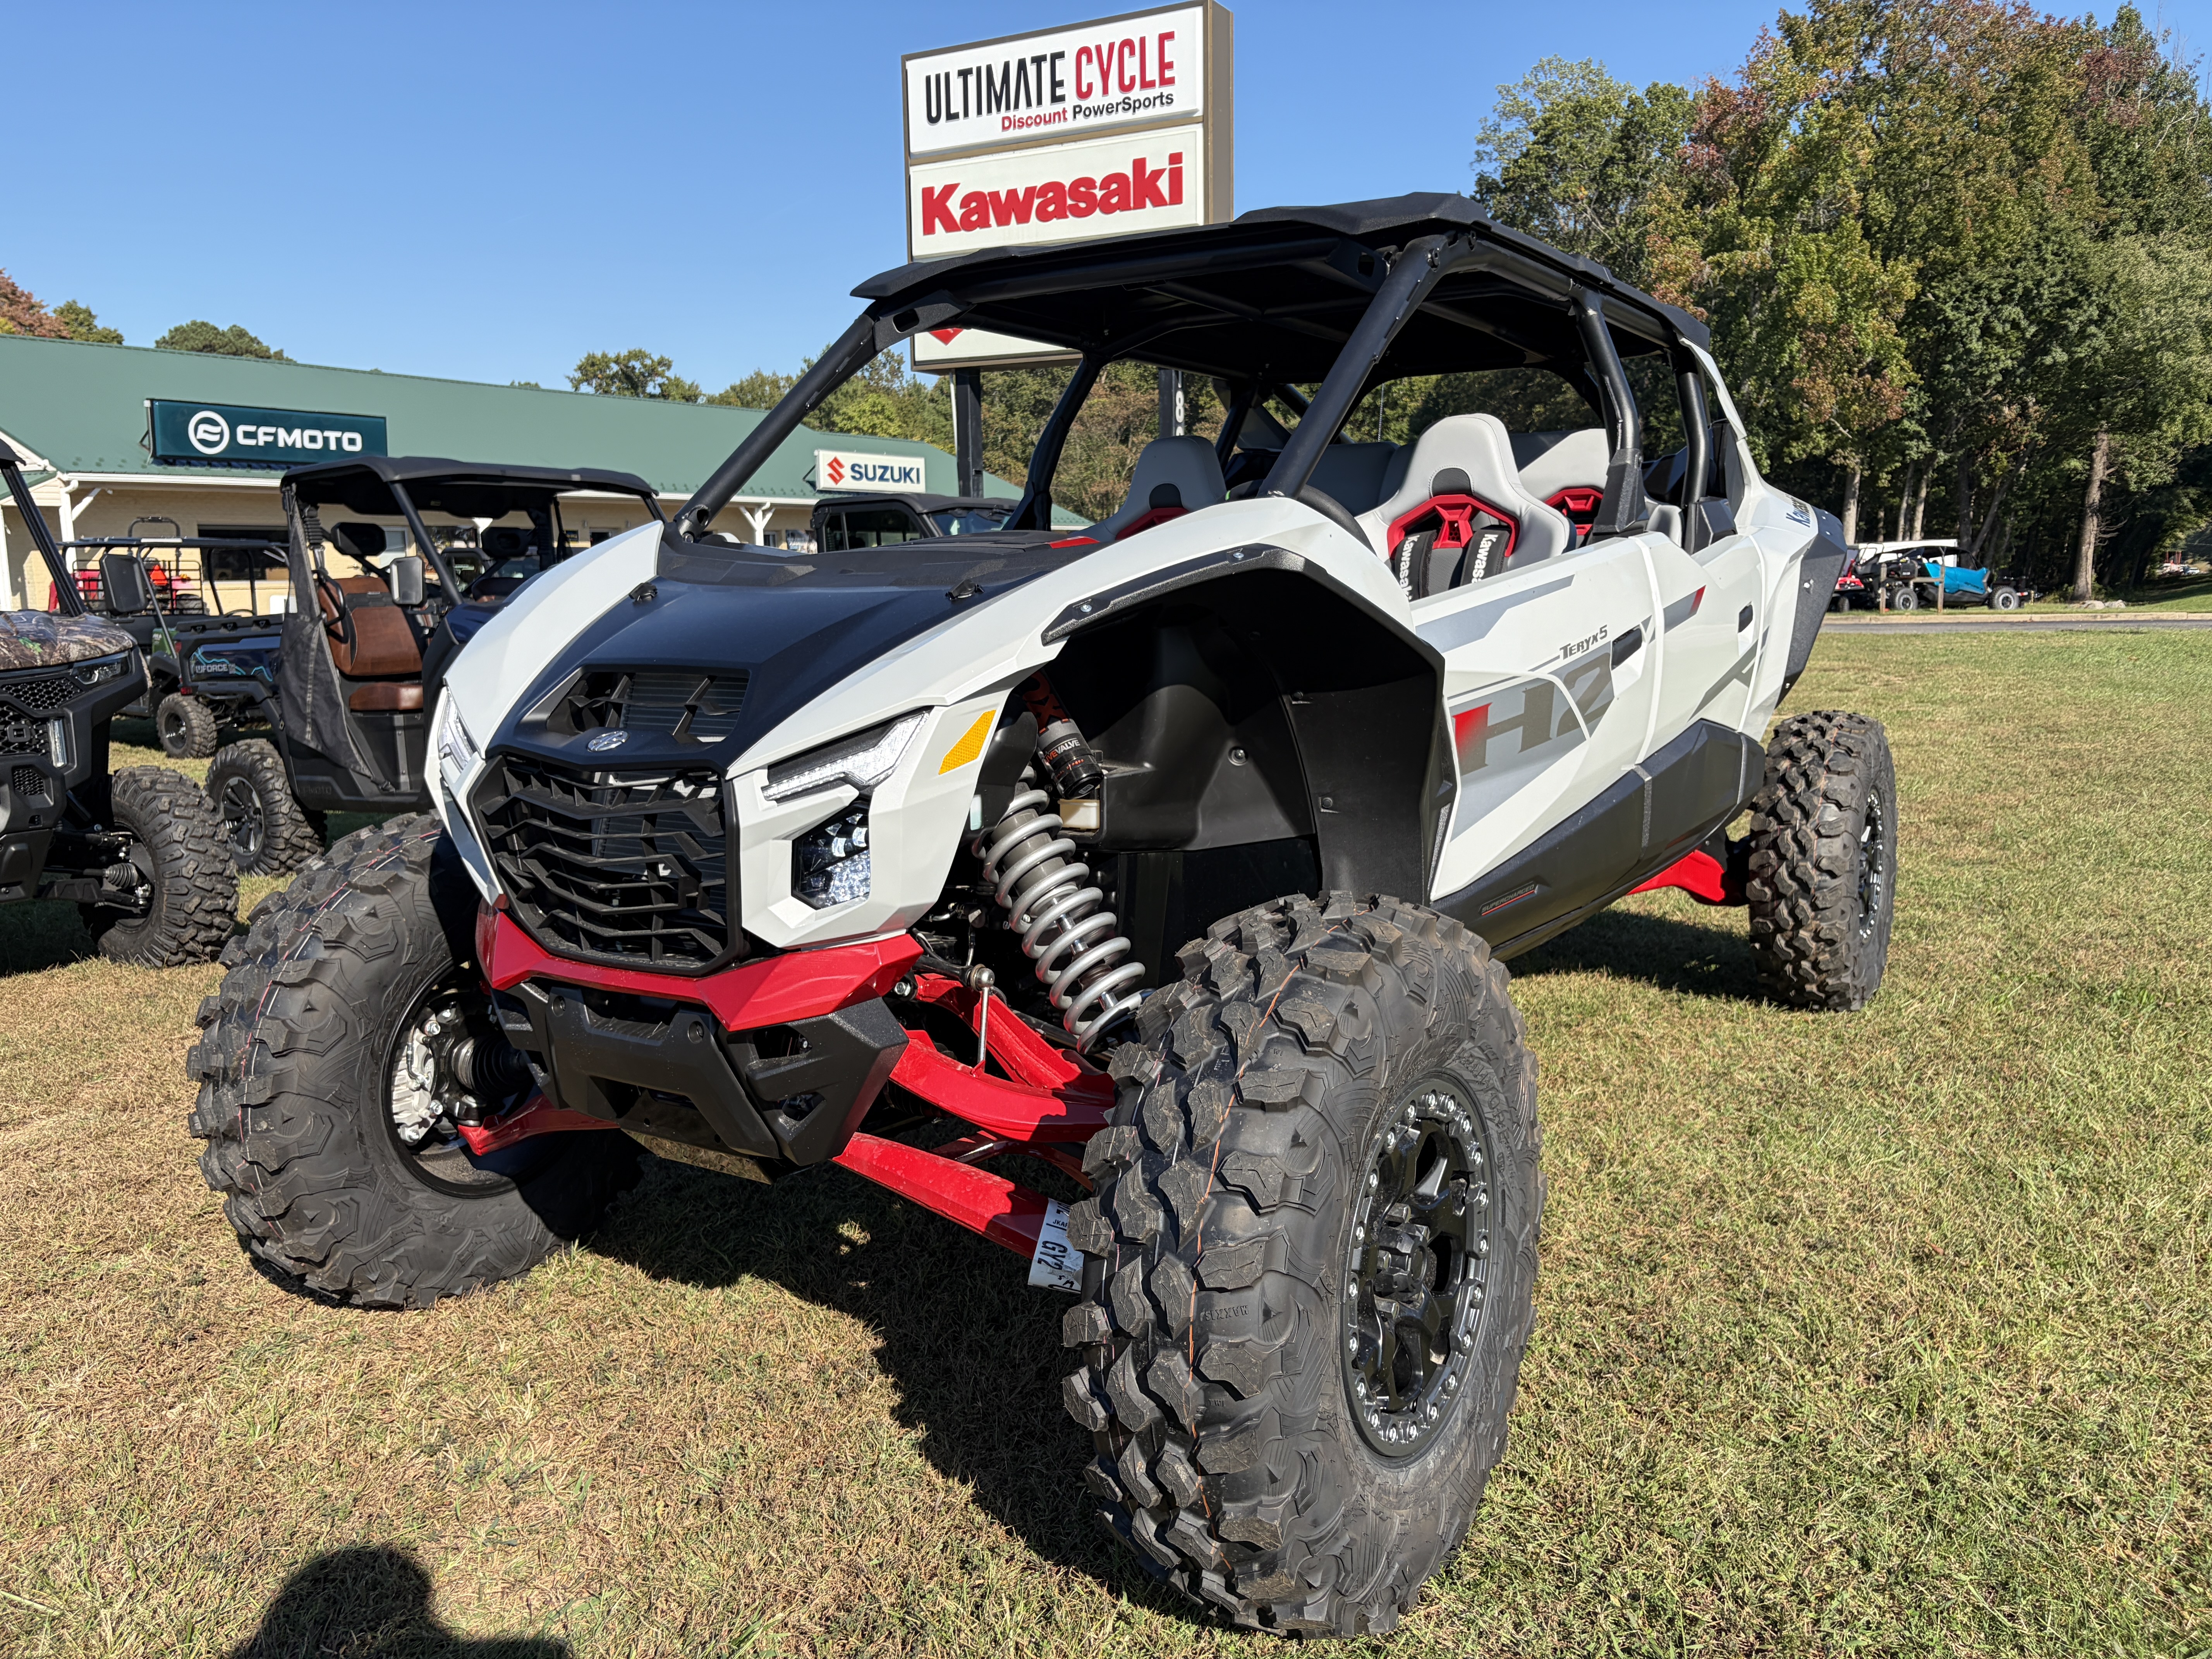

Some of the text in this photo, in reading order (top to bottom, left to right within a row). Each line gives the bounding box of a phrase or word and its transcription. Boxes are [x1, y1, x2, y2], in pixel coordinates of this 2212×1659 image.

[925, 31, 1175, 124] ULTIMATE CYCLE
[1001, 92, 1174, 131] Discount PowerSports
[921, 151, 1183, 235] Kawasaki
[237, 424, 362, 452] CFMOTO
[850, 463, 921, 485] SUZUKI
[1400, 535, 1420, 600] Kawasak
[1452, 652, 1611, 776] H2
[1481, 884, 1535, 913] SUPERCHARGED
[1205, 1304, 1249, 1321] MAXXIS
